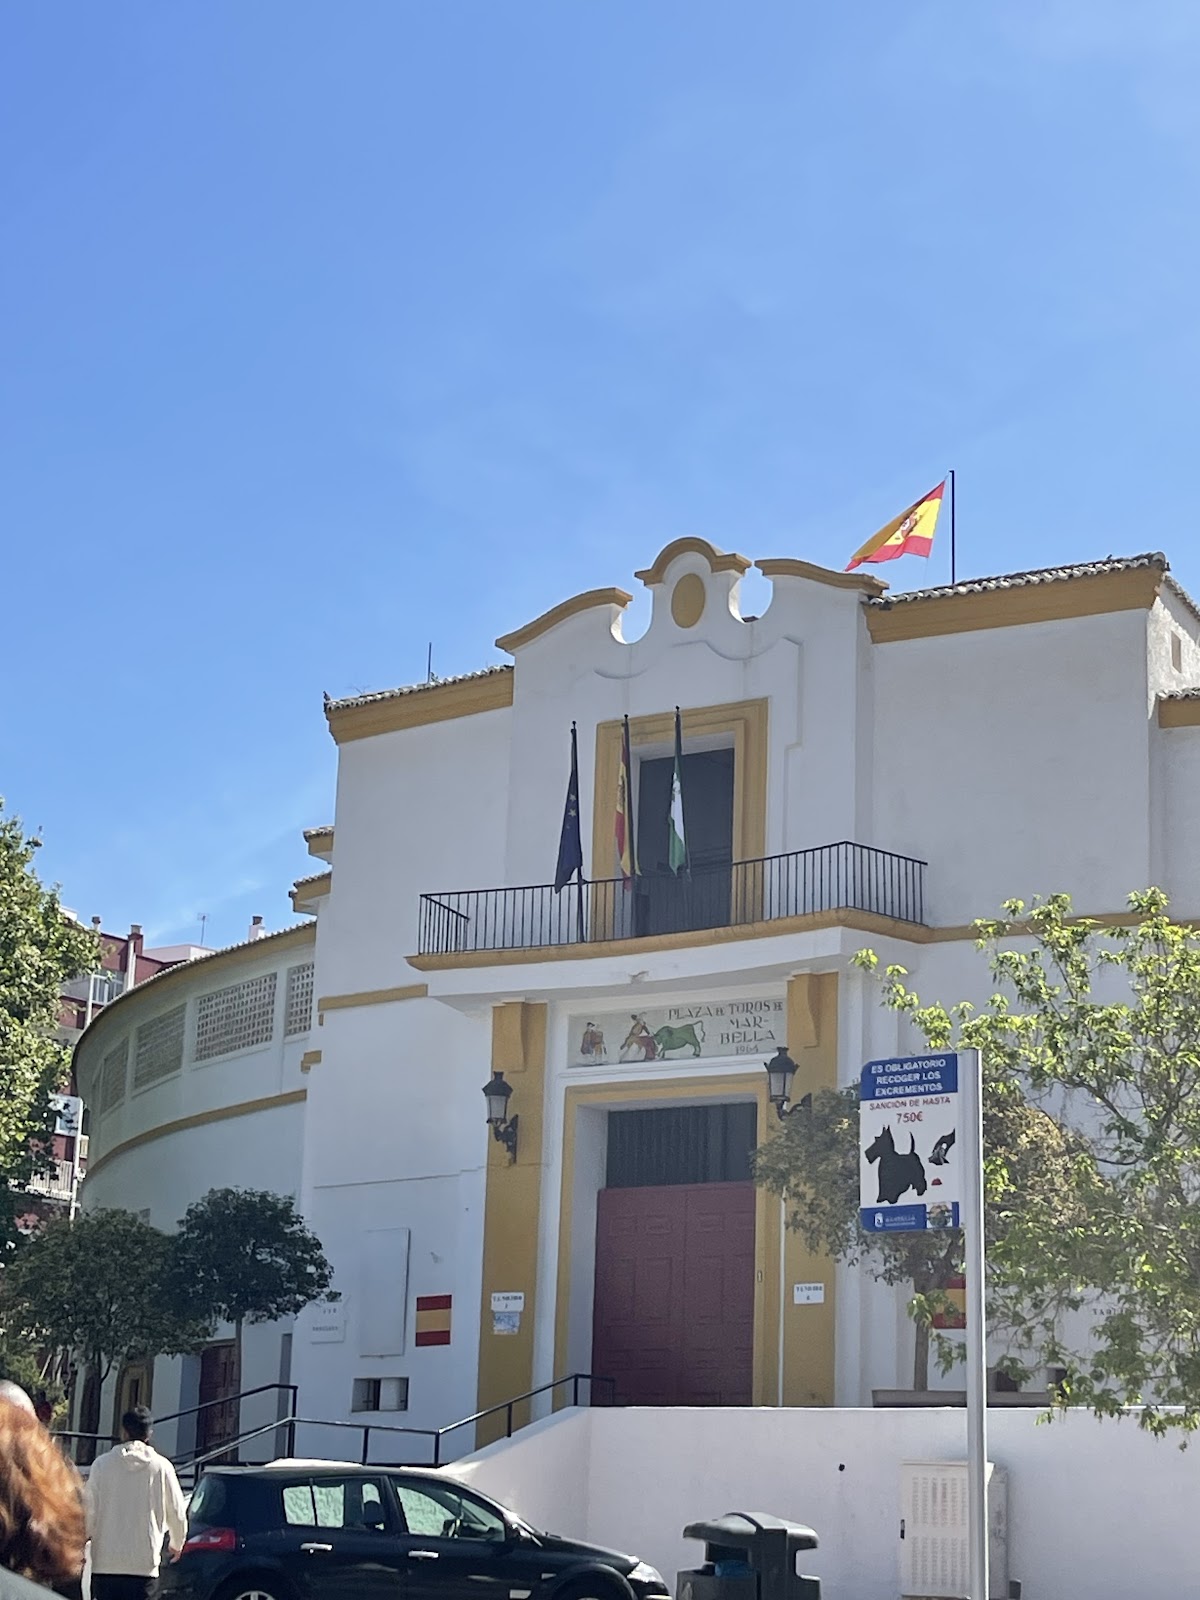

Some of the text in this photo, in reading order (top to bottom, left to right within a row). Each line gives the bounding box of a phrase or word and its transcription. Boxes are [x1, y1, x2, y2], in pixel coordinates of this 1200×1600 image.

[668, 1006, 713, 1020] PLAZA
[728, 1001, 771, 1015] TOROS
[720, 1029, 776, 1045] BELLA
[871, 1059, 946, 1074] ES OBLIGATORIO
[876, 1070, 941, 1084] RECOGER LOS
[875, 1083, 943, 1096] EXCREMENTOS
[909, 1099, 920, 1107] DE
[922, 1096, 951, 1105] HASTA
